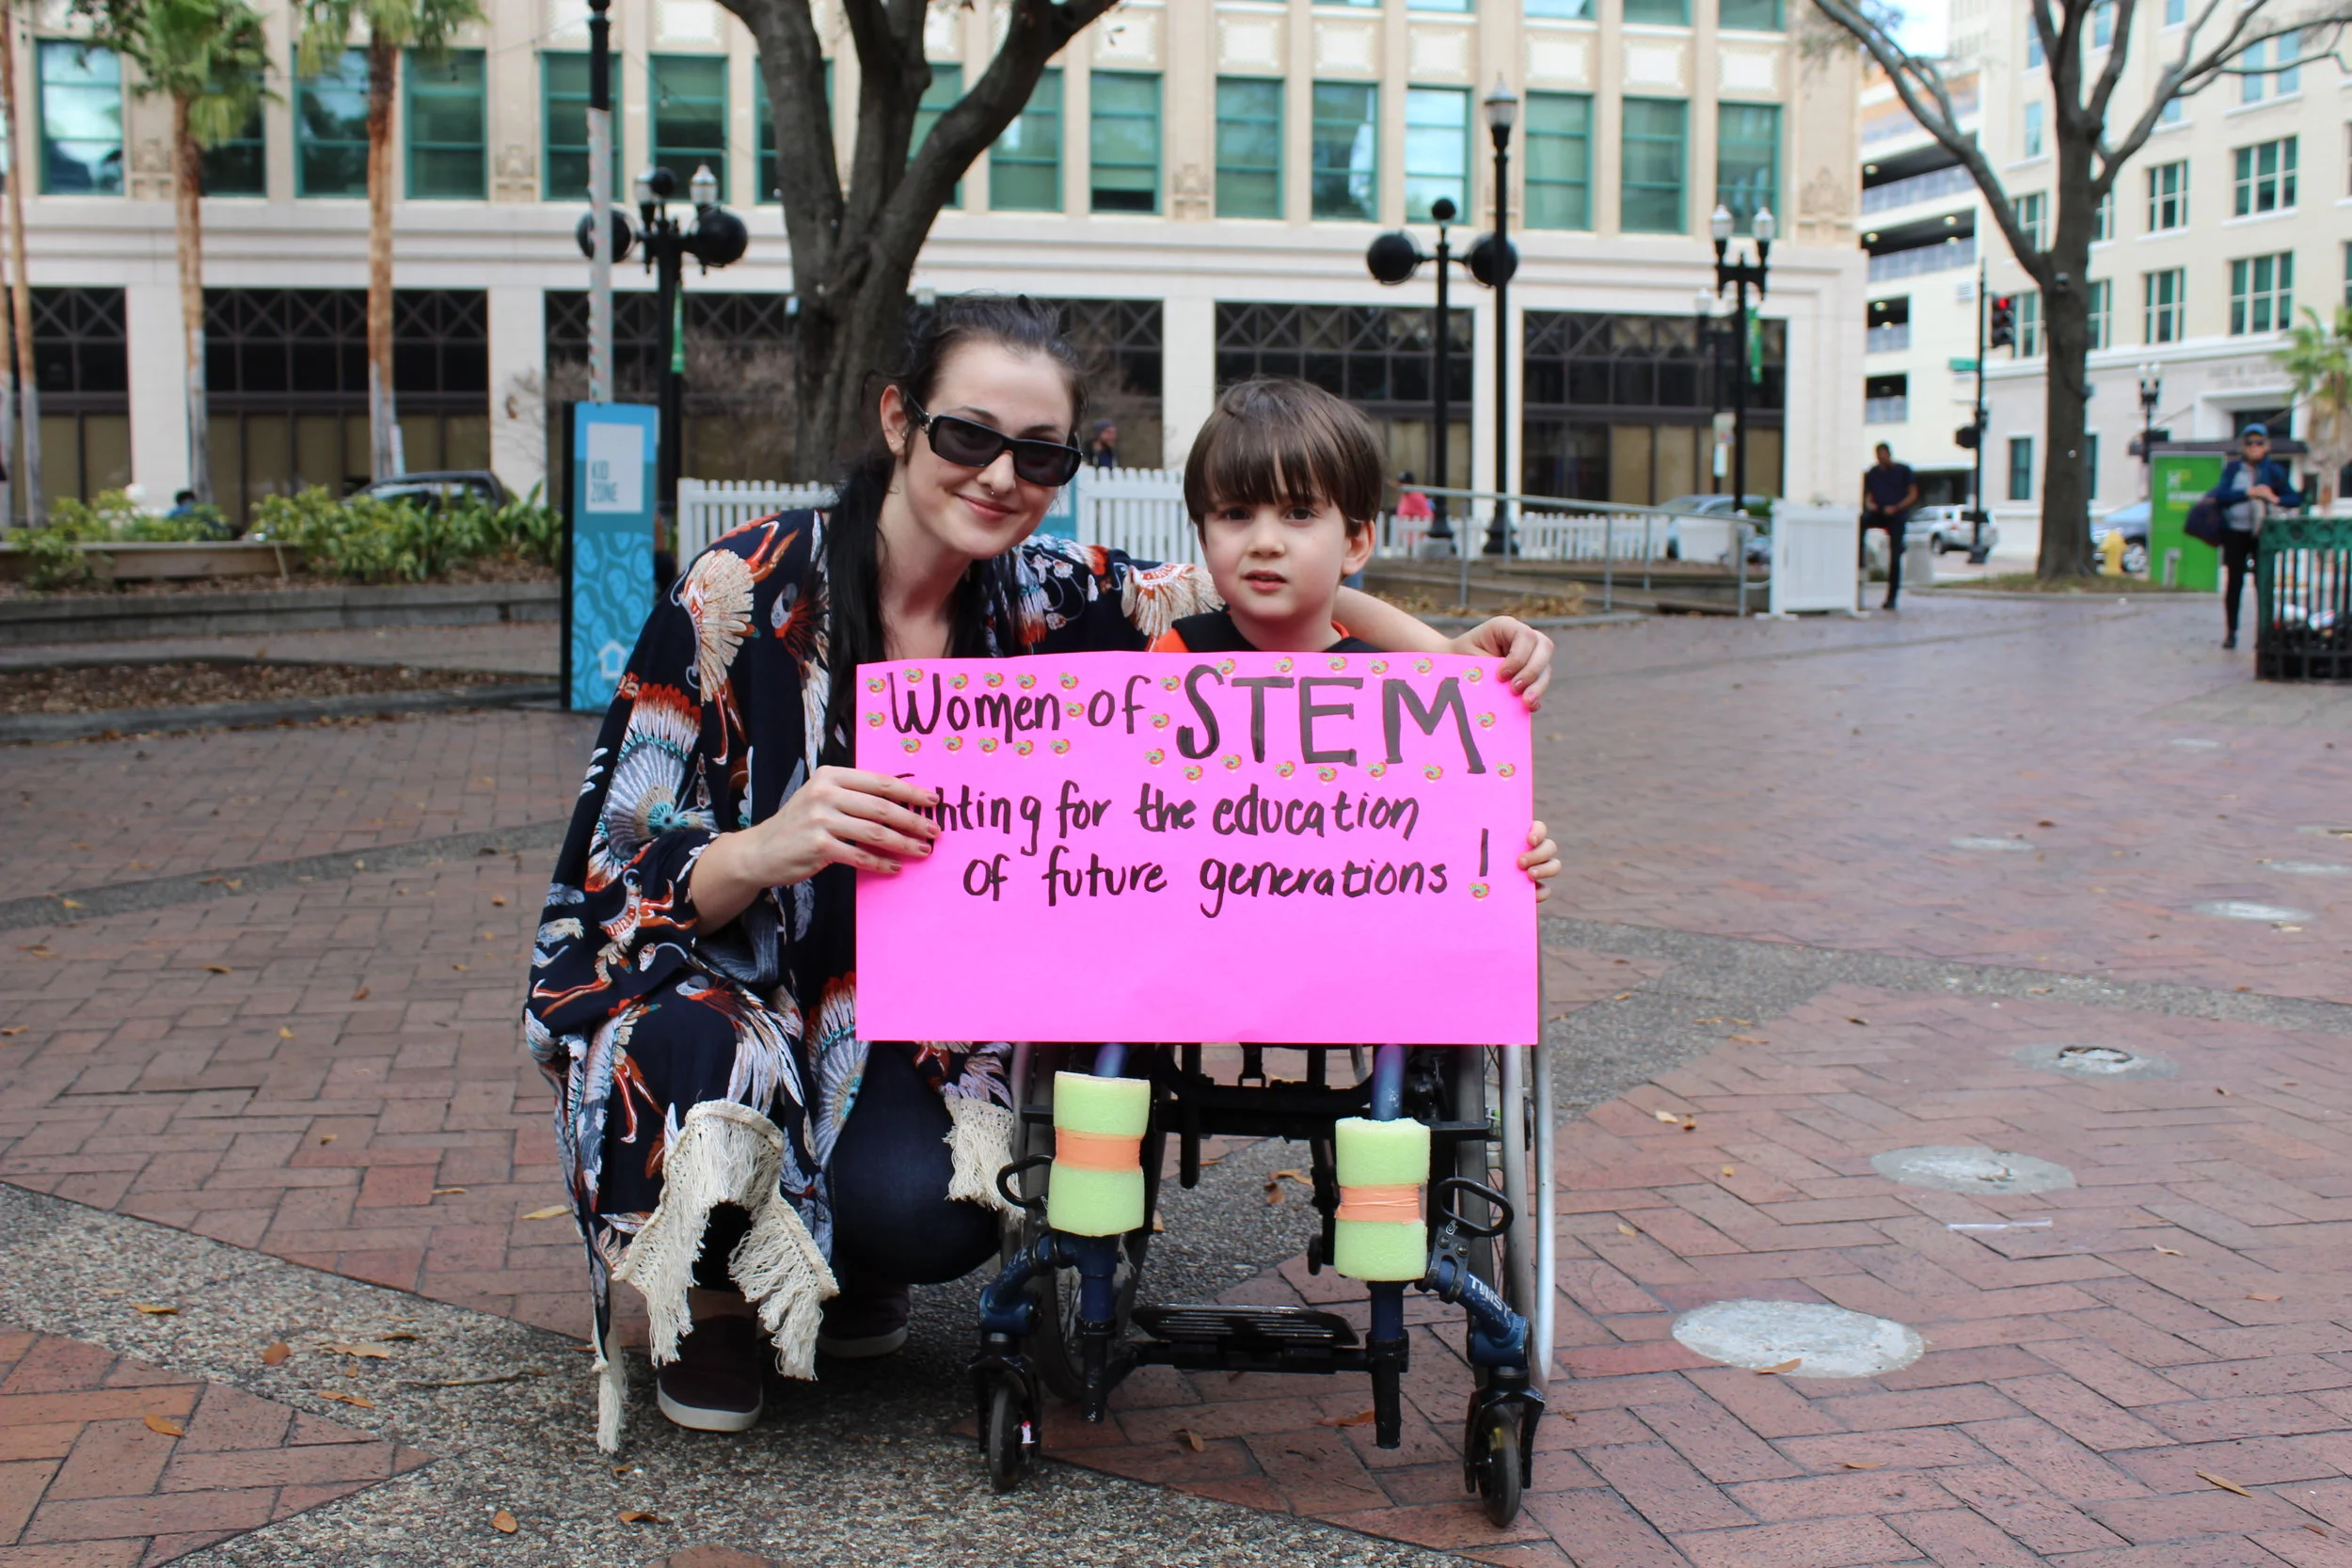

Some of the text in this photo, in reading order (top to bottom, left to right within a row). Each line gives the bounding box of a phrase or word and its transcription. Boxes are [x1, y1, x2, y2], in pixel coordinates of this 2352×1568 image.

[887, 664, 1486, 774] Women of STEM
[1056, 781, 1111, 838] for
[1135, 784, 1196, 832] the
[1213, 784, 1419, 841] education
[1041, 846, 1168, 907] future
[1200, 860, 1448, 919] generations
